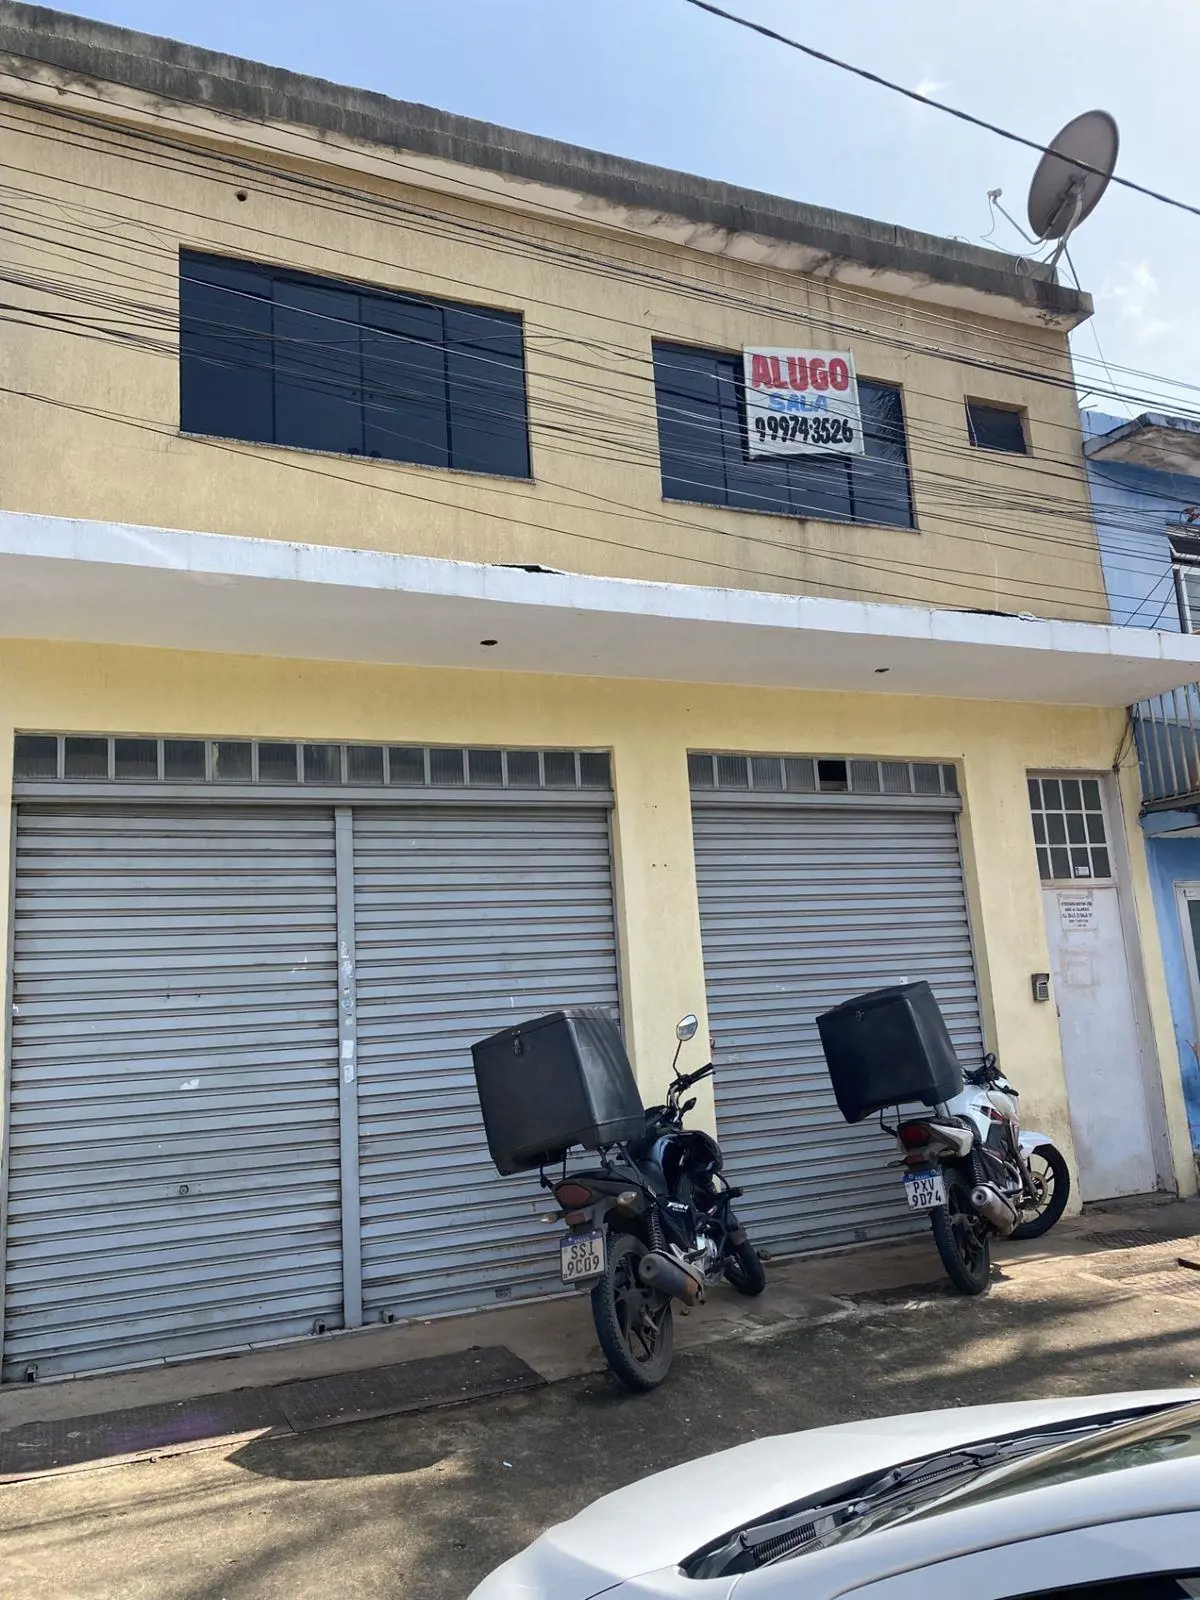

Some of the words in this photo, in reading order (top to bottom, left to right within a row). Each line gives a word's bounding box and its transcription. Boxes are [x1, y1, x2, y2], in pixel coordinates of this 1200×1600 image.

[752, 353, 849, 391] ALUGO
[768, 392, 829, 413] SALA
[913, 1178, 935, 1193] PXV
[912, 1190, 941, 1206] 9D74
[571, 1241, 594, 1259] SSI
